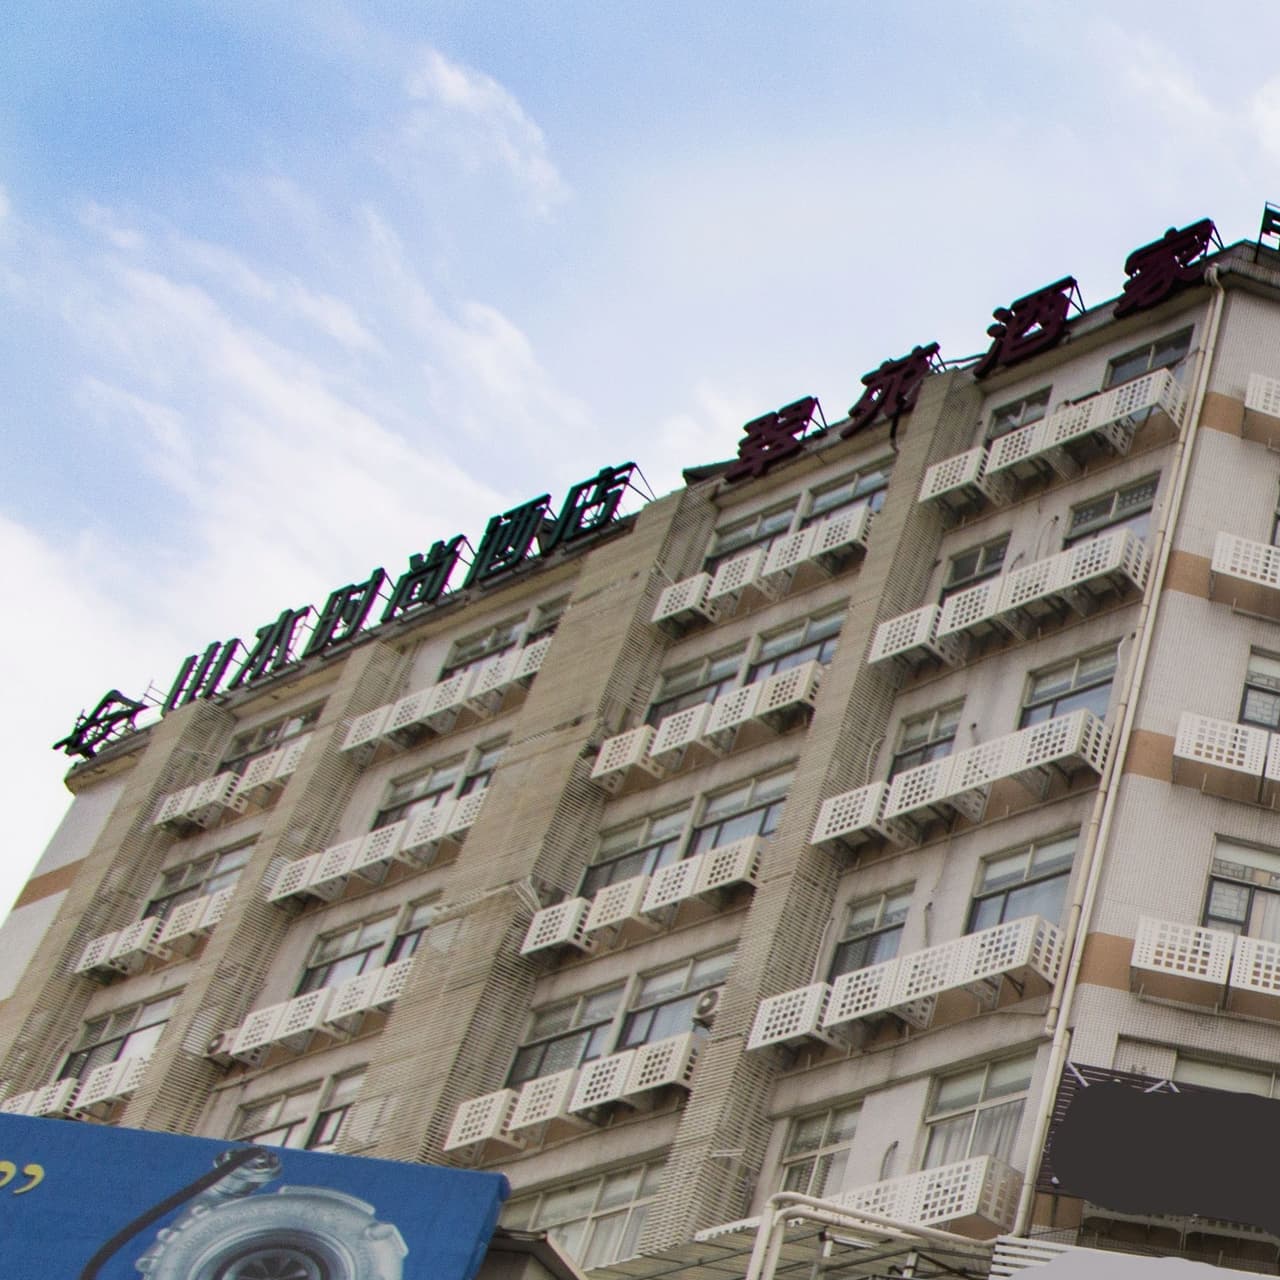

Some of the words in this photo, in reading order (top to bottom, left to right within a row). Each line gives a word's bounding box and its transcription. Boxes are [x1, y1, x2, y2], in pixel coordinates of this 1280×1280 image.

[161, 461, 639, 717] 山水时尚酒店
